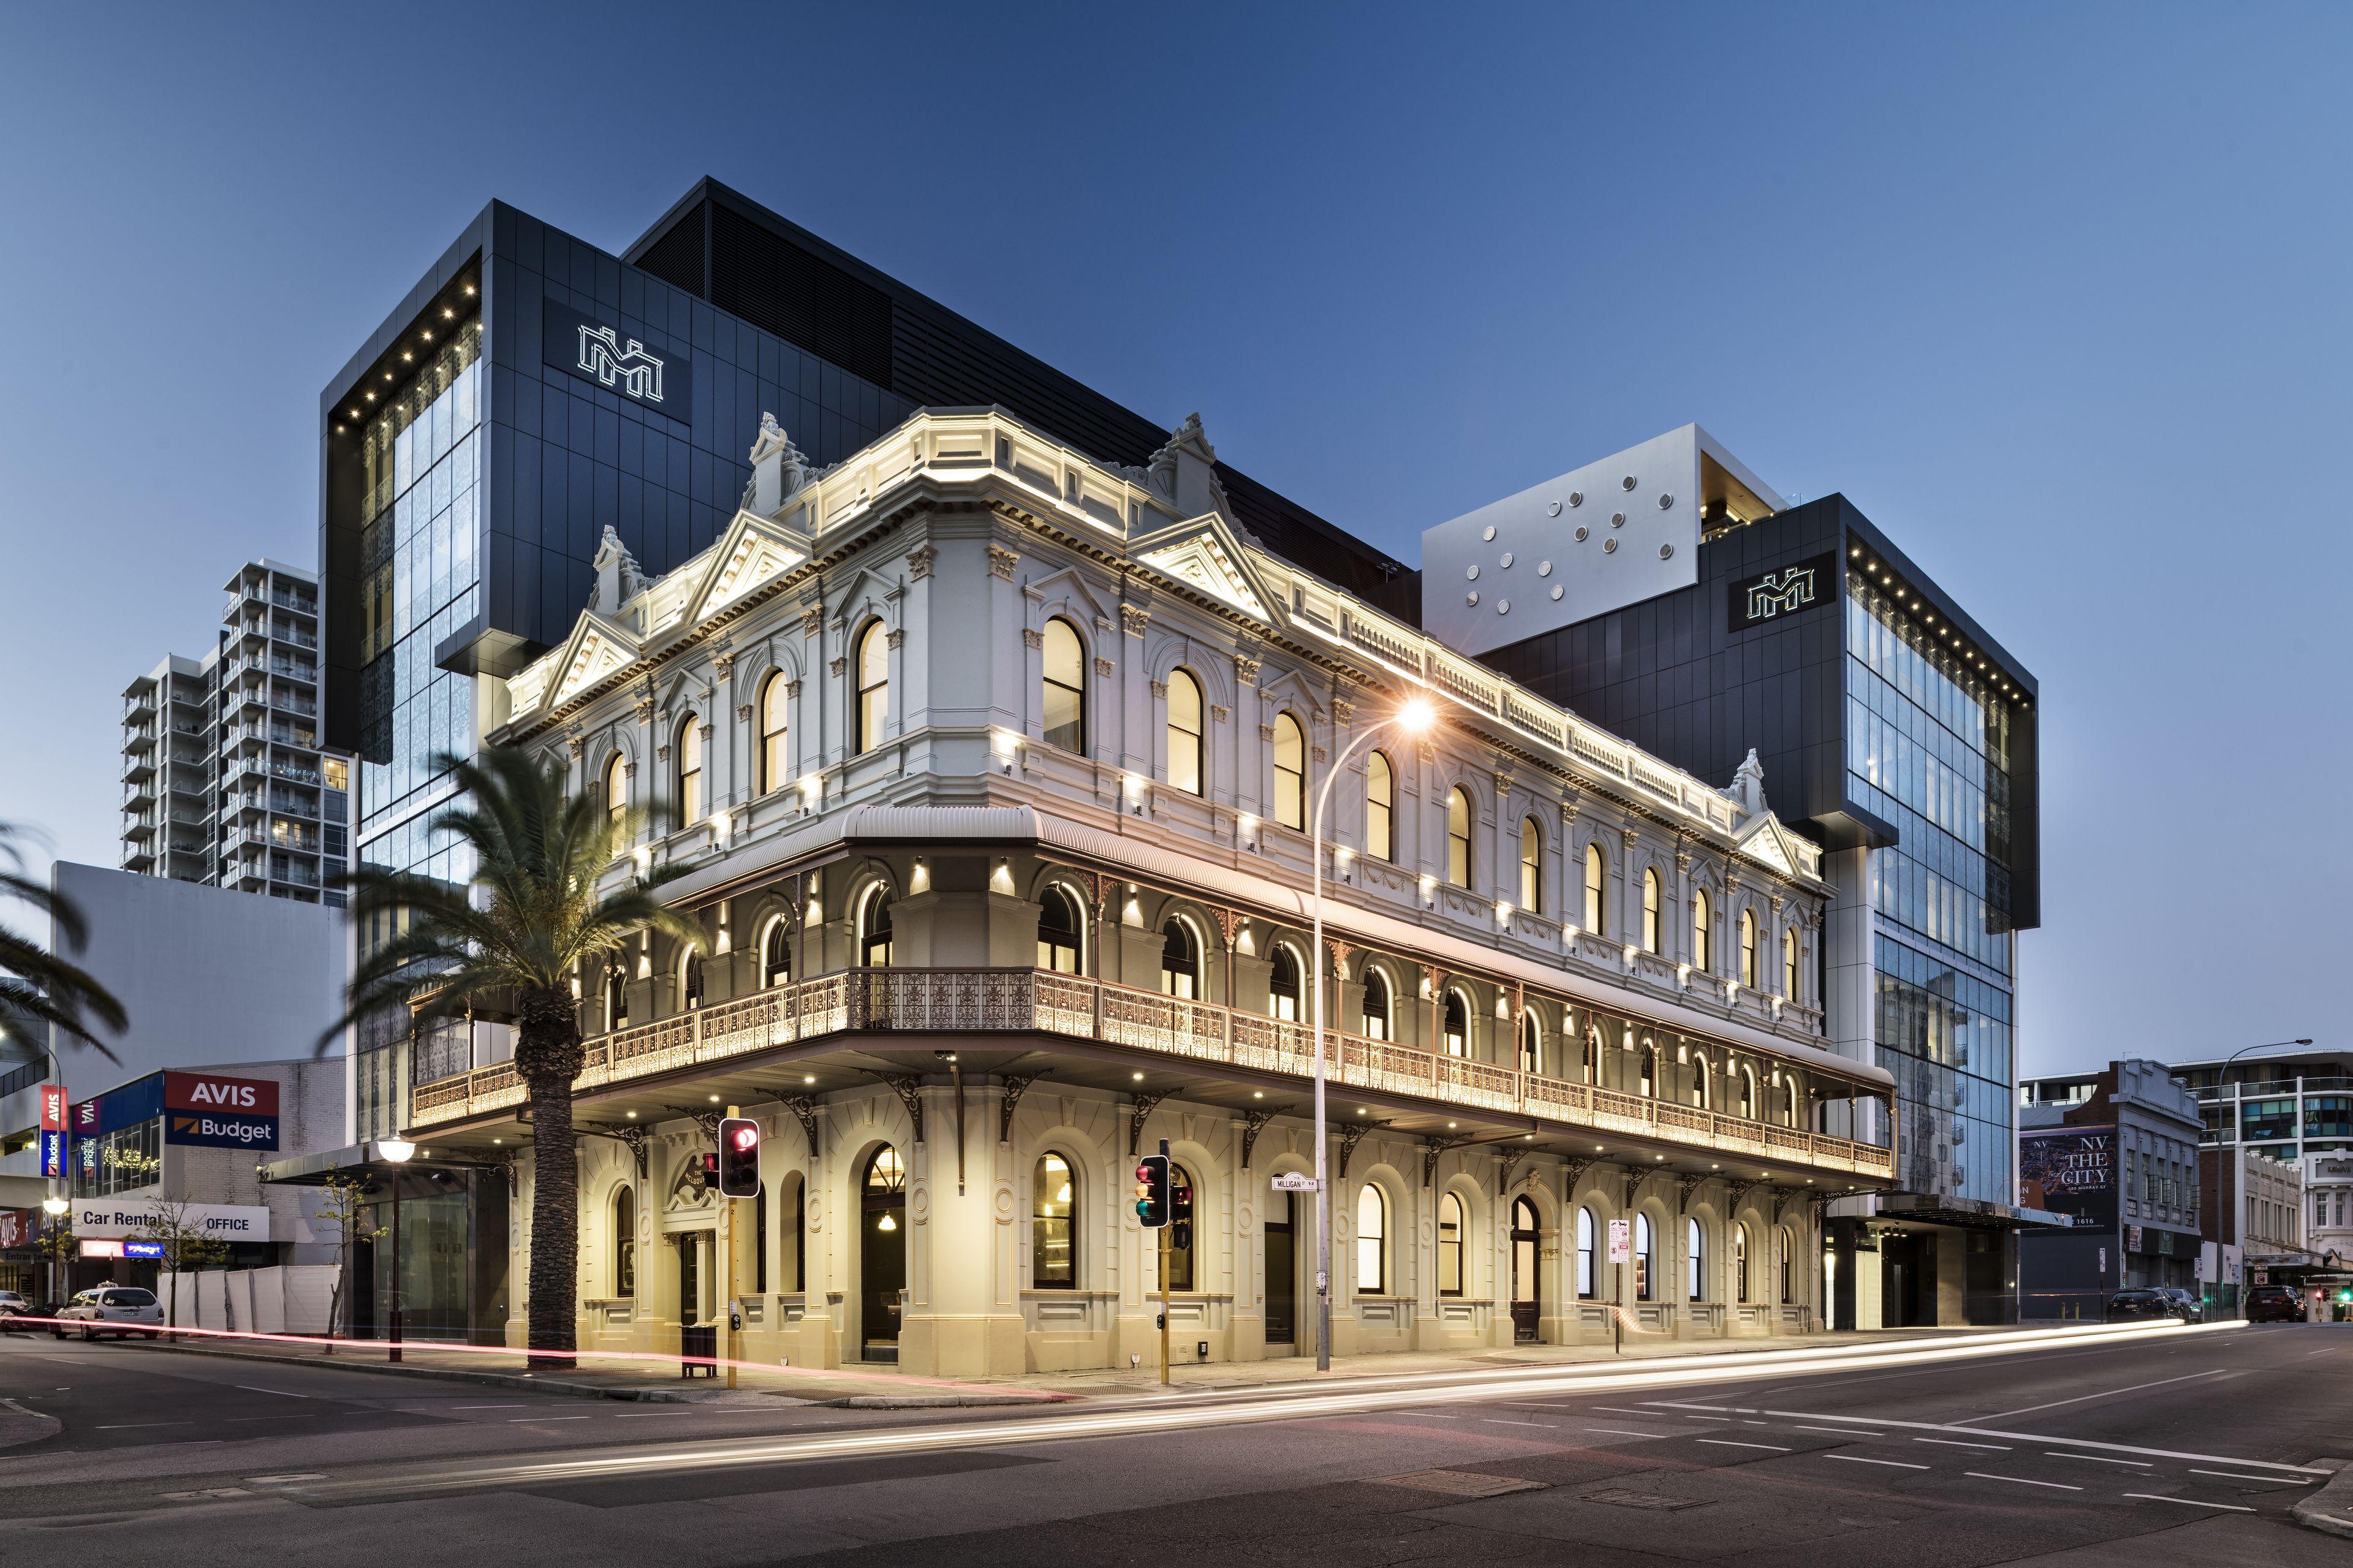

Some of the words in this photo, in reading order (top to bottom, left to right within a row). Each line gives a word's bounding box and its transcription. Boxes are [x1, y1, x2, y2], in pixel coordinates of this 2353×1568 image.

[190, 1082, 256, 1107] AVIS
[48, 1094, 59, 1122] AVIS
[202, 1119, 271, 1142] Budget
[2080, 1136, 2109, 1151] NV
[2064, 1153, 2108, 1168] THE
[2061, 1169, 2109, 1185] CITY
[83, 1211, 110, 1224] Car
[115, 1212, 162, 1226] Rental
[206, 1218, 249, 1230] OFFICE
[1, 1216, 17, 1243] AVIS
